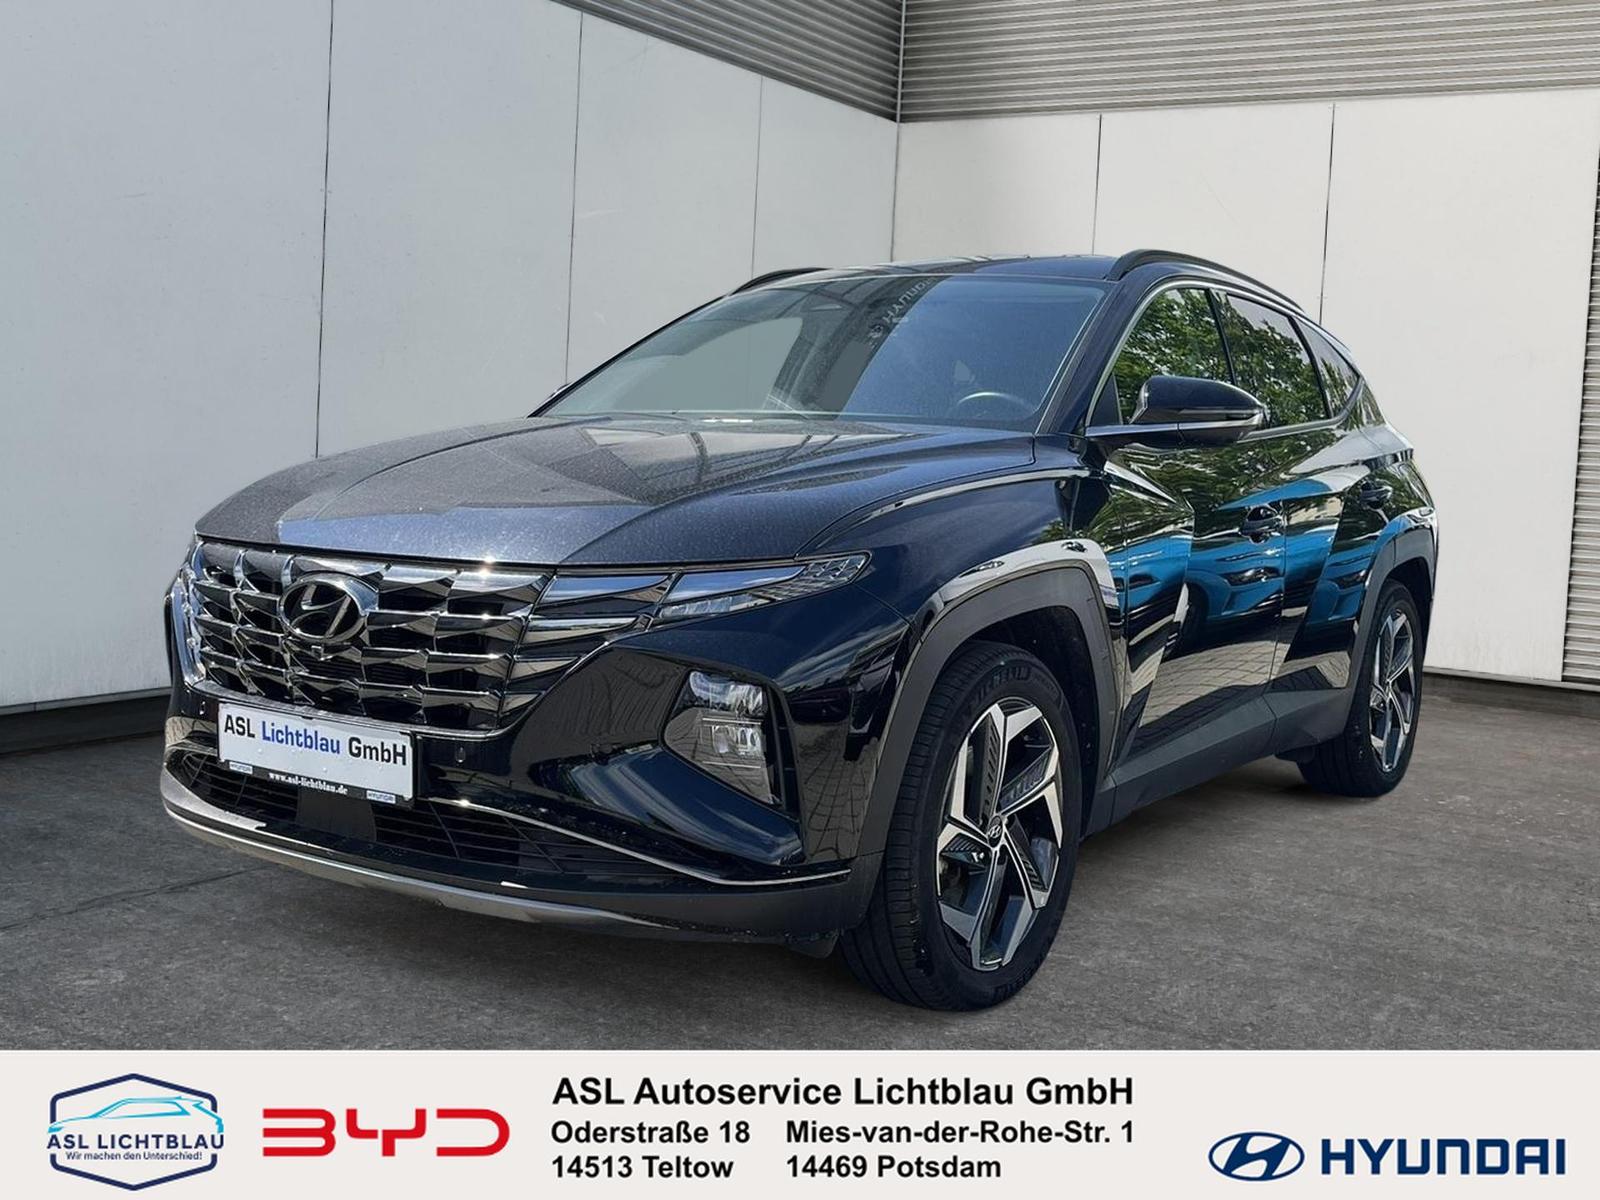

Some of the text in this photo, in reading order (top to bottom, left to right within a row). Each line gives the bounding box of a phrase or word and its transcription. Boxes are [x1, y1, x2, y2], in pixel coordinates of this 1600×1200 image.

[223, 714, 407, 766] ASL Lichtblau GmbH
[268, 772, 349, 796] www.asl-lichtblau.de
